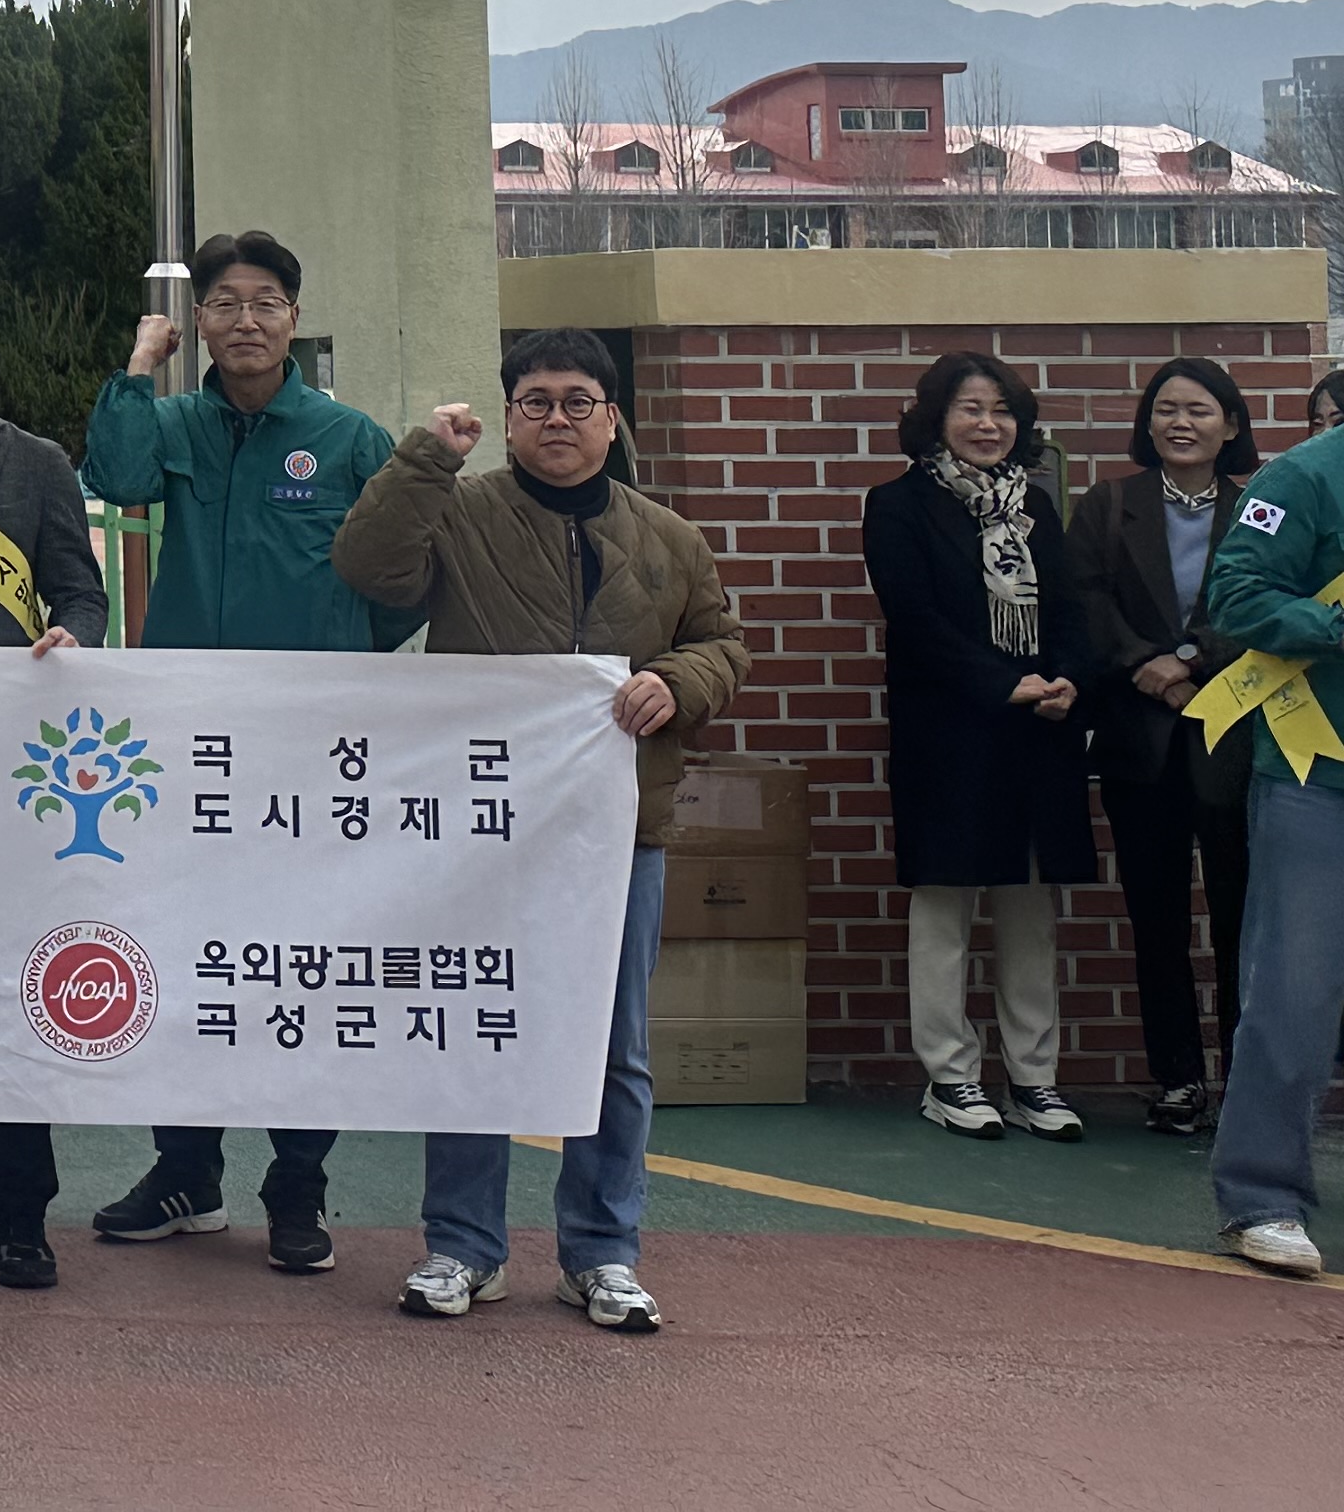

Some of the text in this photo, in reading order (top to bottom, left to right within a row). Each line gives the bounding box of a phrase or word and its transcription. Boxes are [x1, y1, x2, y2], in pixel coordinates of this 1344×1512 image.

[193, 794, 515, 842] 도시경제과
[195, 940, 515, 992] 옥외광고물협회
[197, 1003, 518, 1052] 곡성군지부
